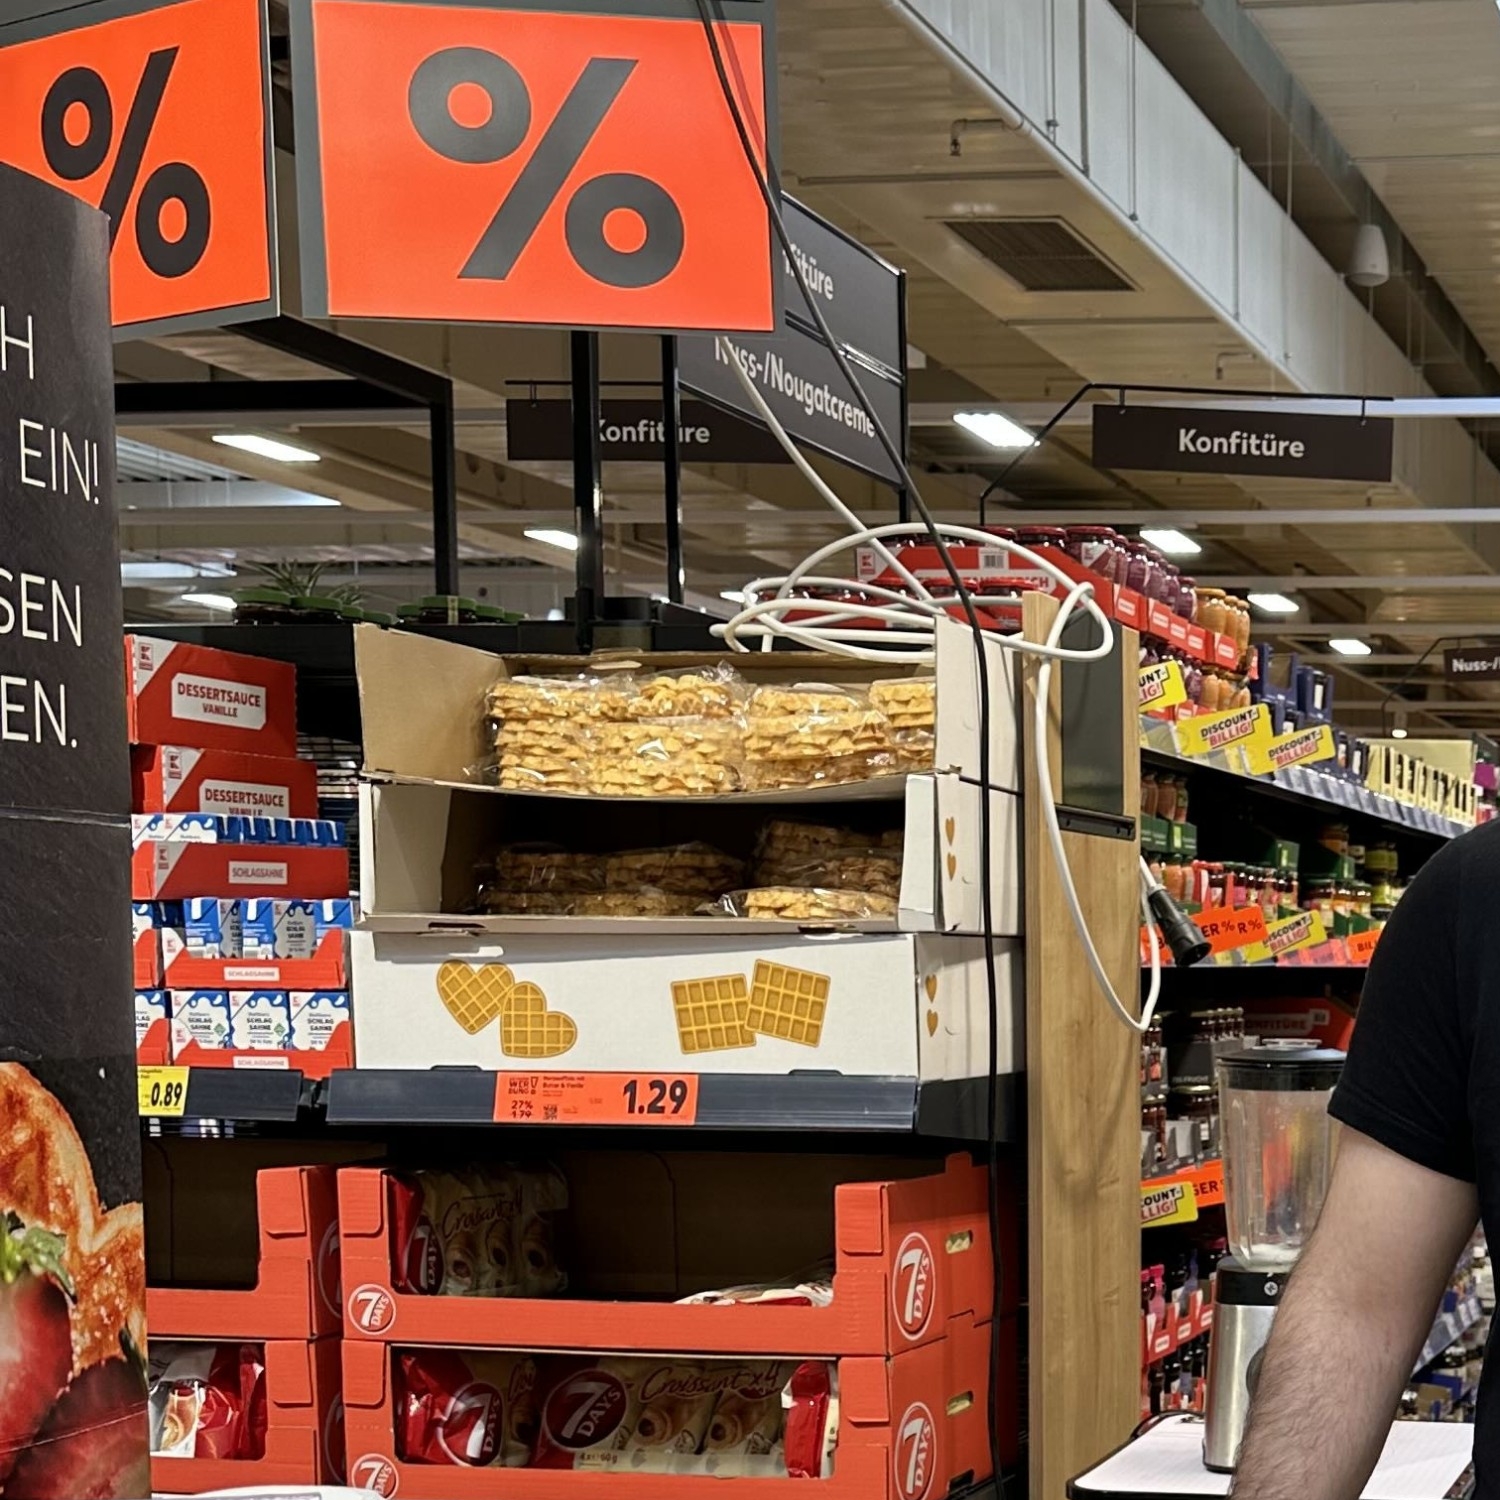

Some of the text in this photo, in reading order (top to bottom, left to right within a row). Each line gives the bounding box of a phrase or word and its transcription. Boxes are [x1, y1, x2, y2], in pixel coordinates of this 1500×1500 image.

[596, 418, 711, 444] Konfitre
[1179, 428, 1306, 459] Konfitüre
[20, 418, 99, 505] EIN!
[177, 682, 261, 707] DESSERTSAUCE
[202, 703, 238, 718] VANILLE
[1201, 707, 1258, 739] DISCOUNT-
[1209, 724, 1253, 747] BILLIG!
[1269, 729, 1322, 759] DISCOUNT-
[1276, 744, 1317, 767] BILLIG!
[205, 787, 284, 808] DESSERTSAUCE
[232, 867, 285, 879] SCHLAGSAHNE
[150, 1082, 184, 1107] 0.89
[511, 1100, 533, 1110] 27%
[623, 1078, 688, 1115] 1.29
[899, 1248, 930, 1325] 7 DAYS
[357, 1291, 389, 1328] 7 DAYS
[576, 1389, 622, 1438] DAYS
[901, 1418, 931, 1495] 7 DAYS
